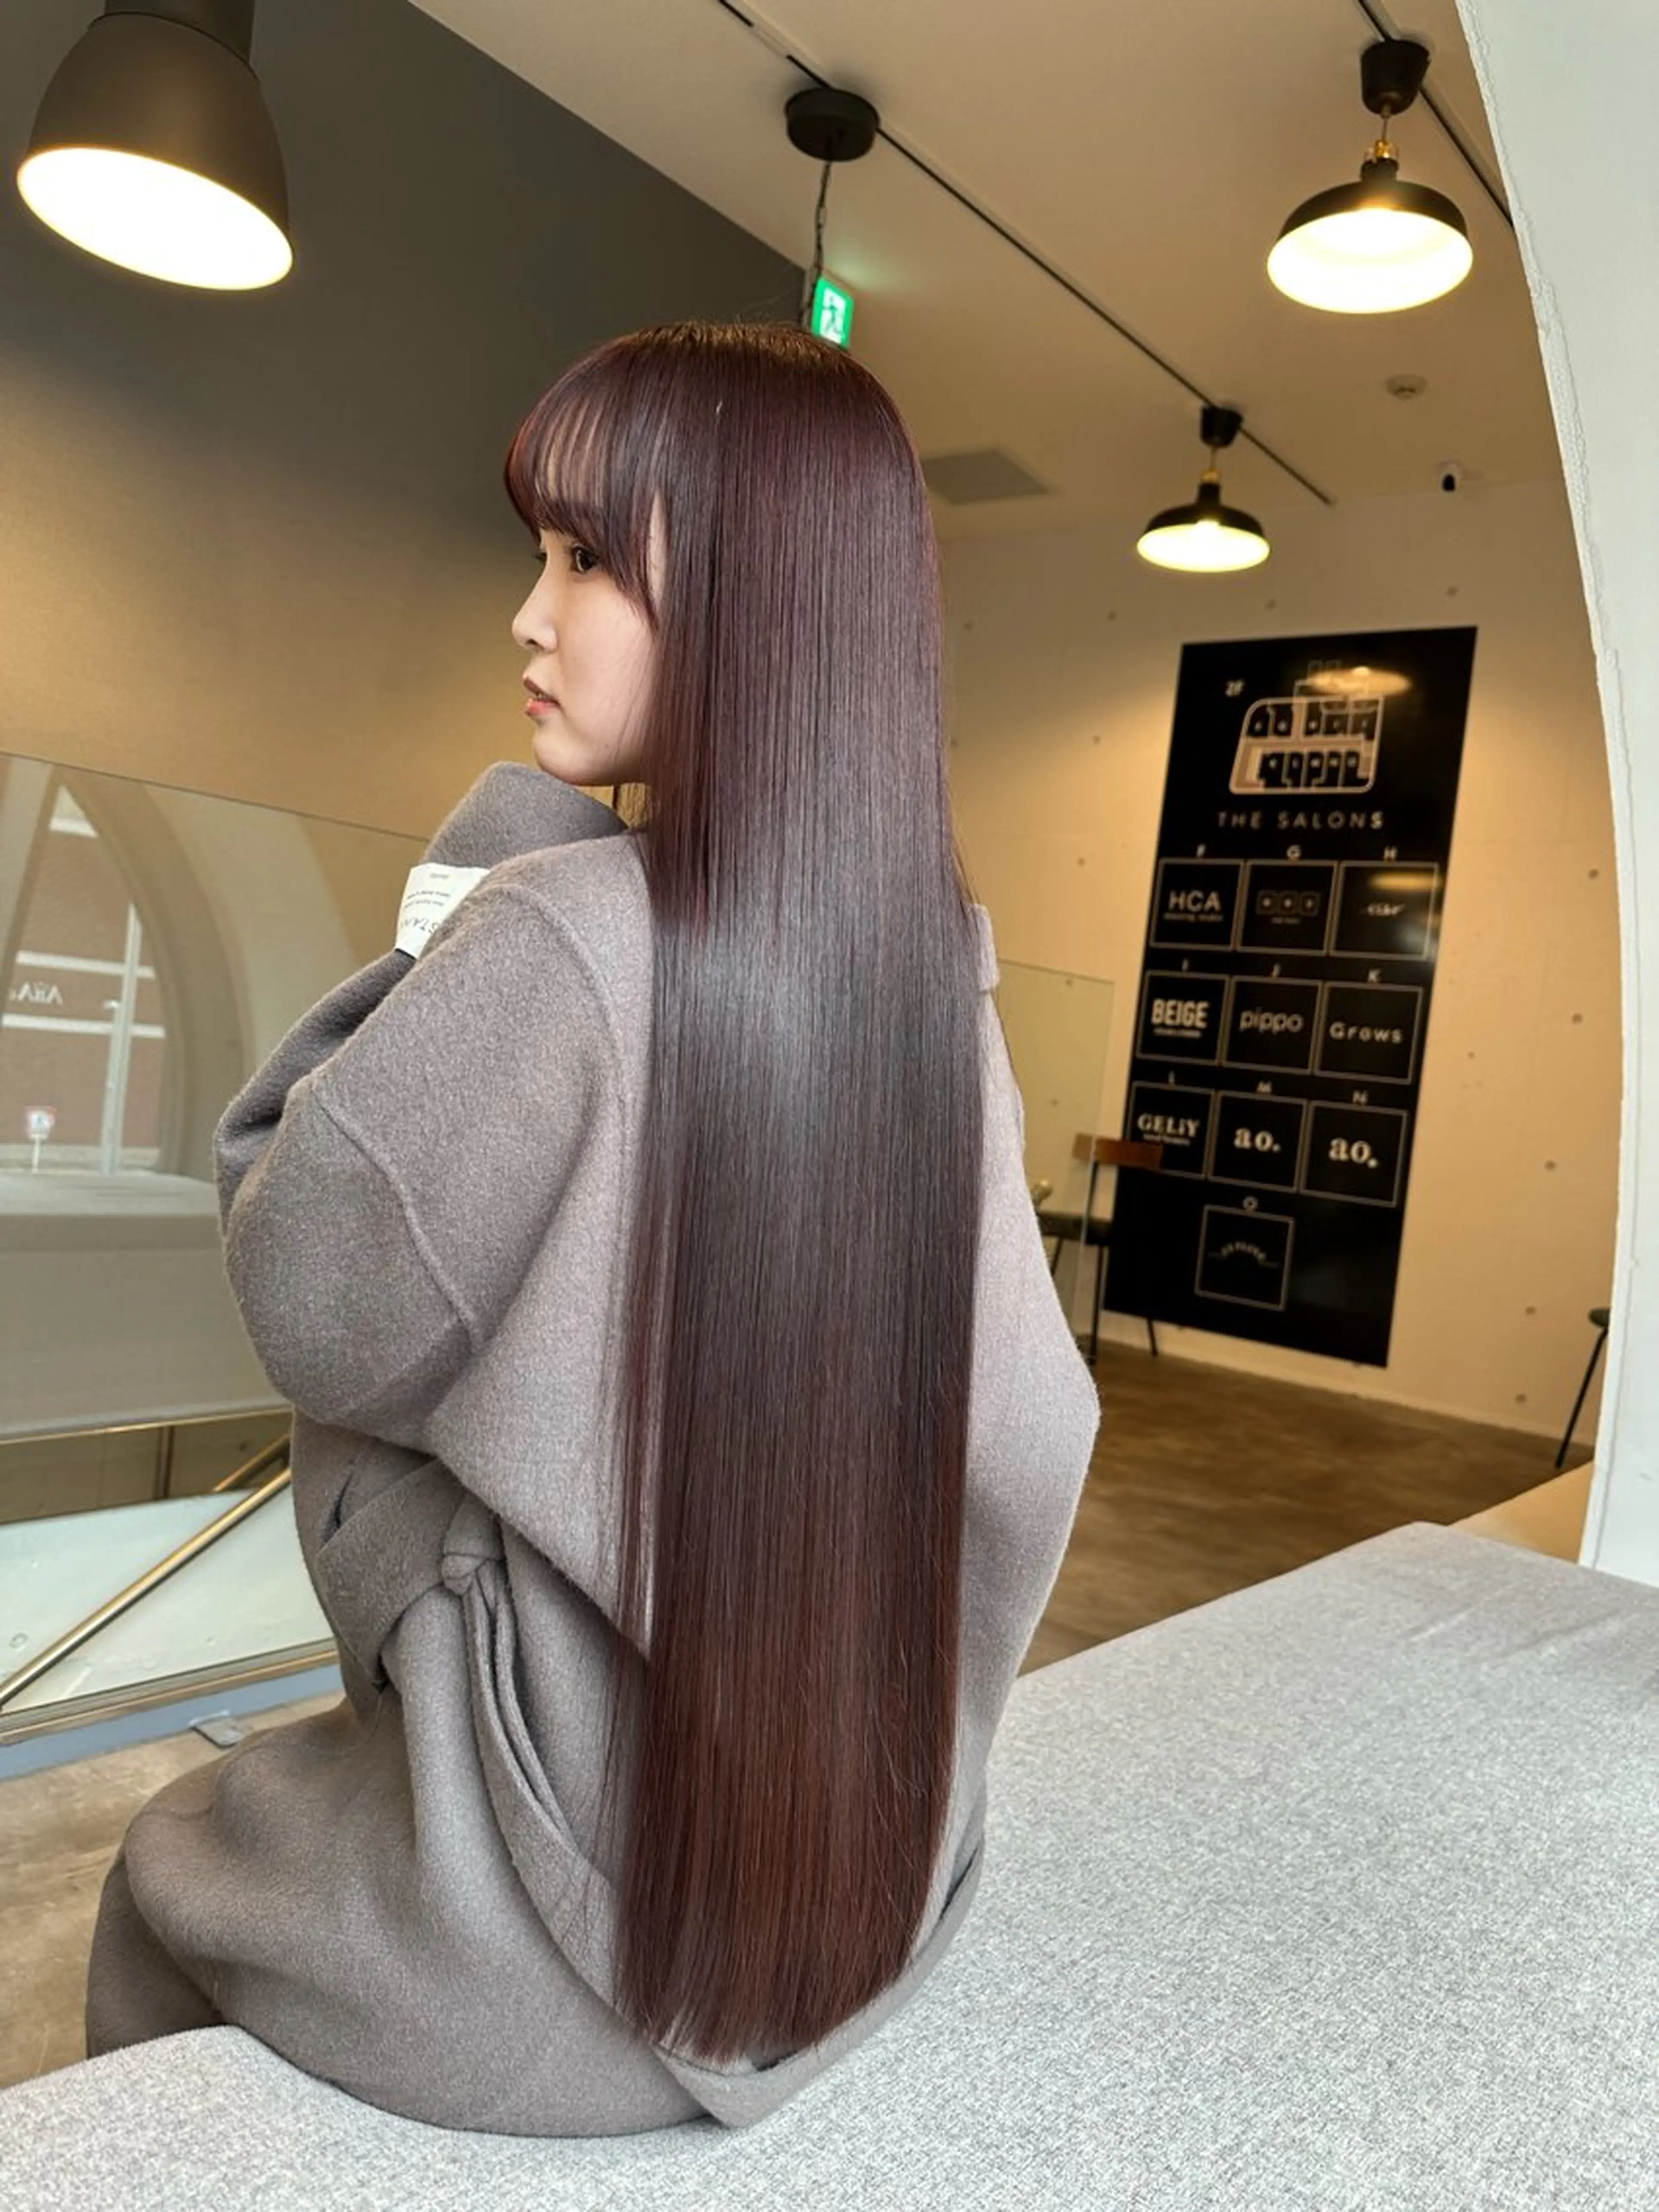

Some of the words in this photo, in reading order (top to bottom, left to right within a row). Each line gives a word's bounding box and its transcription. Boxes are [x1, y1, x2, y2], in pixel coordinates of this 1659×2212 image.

[1217, 810, 1263, 830] THE
[1277, 810, 1384, 830] SALONS
[1168, 890, 1222, 912] HCA
[1151, 998, 1210, 1029] BEIGE
[1239, 1007, 1305, 1035] pippo
[1329, 1020, 1404, 1044] Grows
[1233, 1127, 1281, 1153] ao.
[1327, 1136, 1379, 1169] ao.
